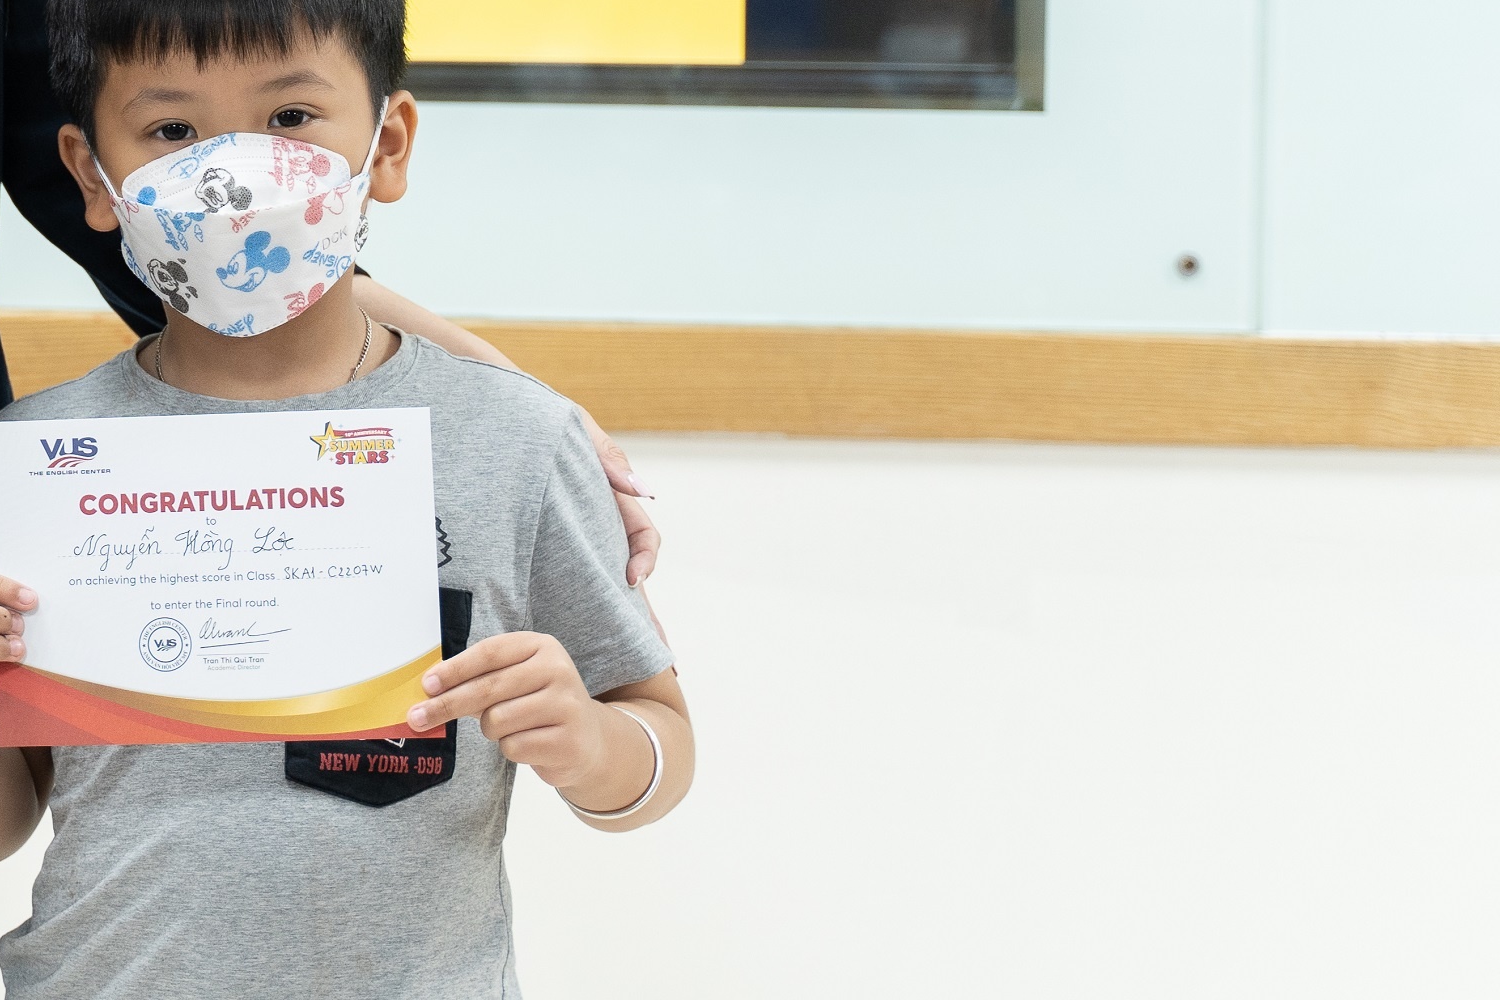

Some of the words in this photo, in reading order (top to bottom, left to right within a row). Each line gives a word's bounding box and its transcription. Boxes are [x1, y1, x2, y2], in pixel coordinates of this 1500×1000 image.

[40, 437, 98, 460] VUS
[329, 439, 395, 452] SUMMER
[335, 450, 389, 465] STARS
[79, 486, 345, 515] CONGRATULATIONS
[206, 517, 217, 526] to
[69, 578, 82, 586] on
[85, 575, 136, 586] achieving
[139, 574, 156, 584] the
[160, 573, 199, 585] highest
[202, 573, 231, 582] score
[234, 571, 243, 581] in
[246, 570, 276, 580] Class
[150, 601, 161, 610] to
[164, 600, 192, 610] enter
[195, 599, 212, 609] the
[216, 597, 242, 608] Final
[245, 597, 280, 607] round.
[154, 638, 177, 648] VUS
[319, 752, 361, 772] NEW
[366, 753, 409, 773] YORK
